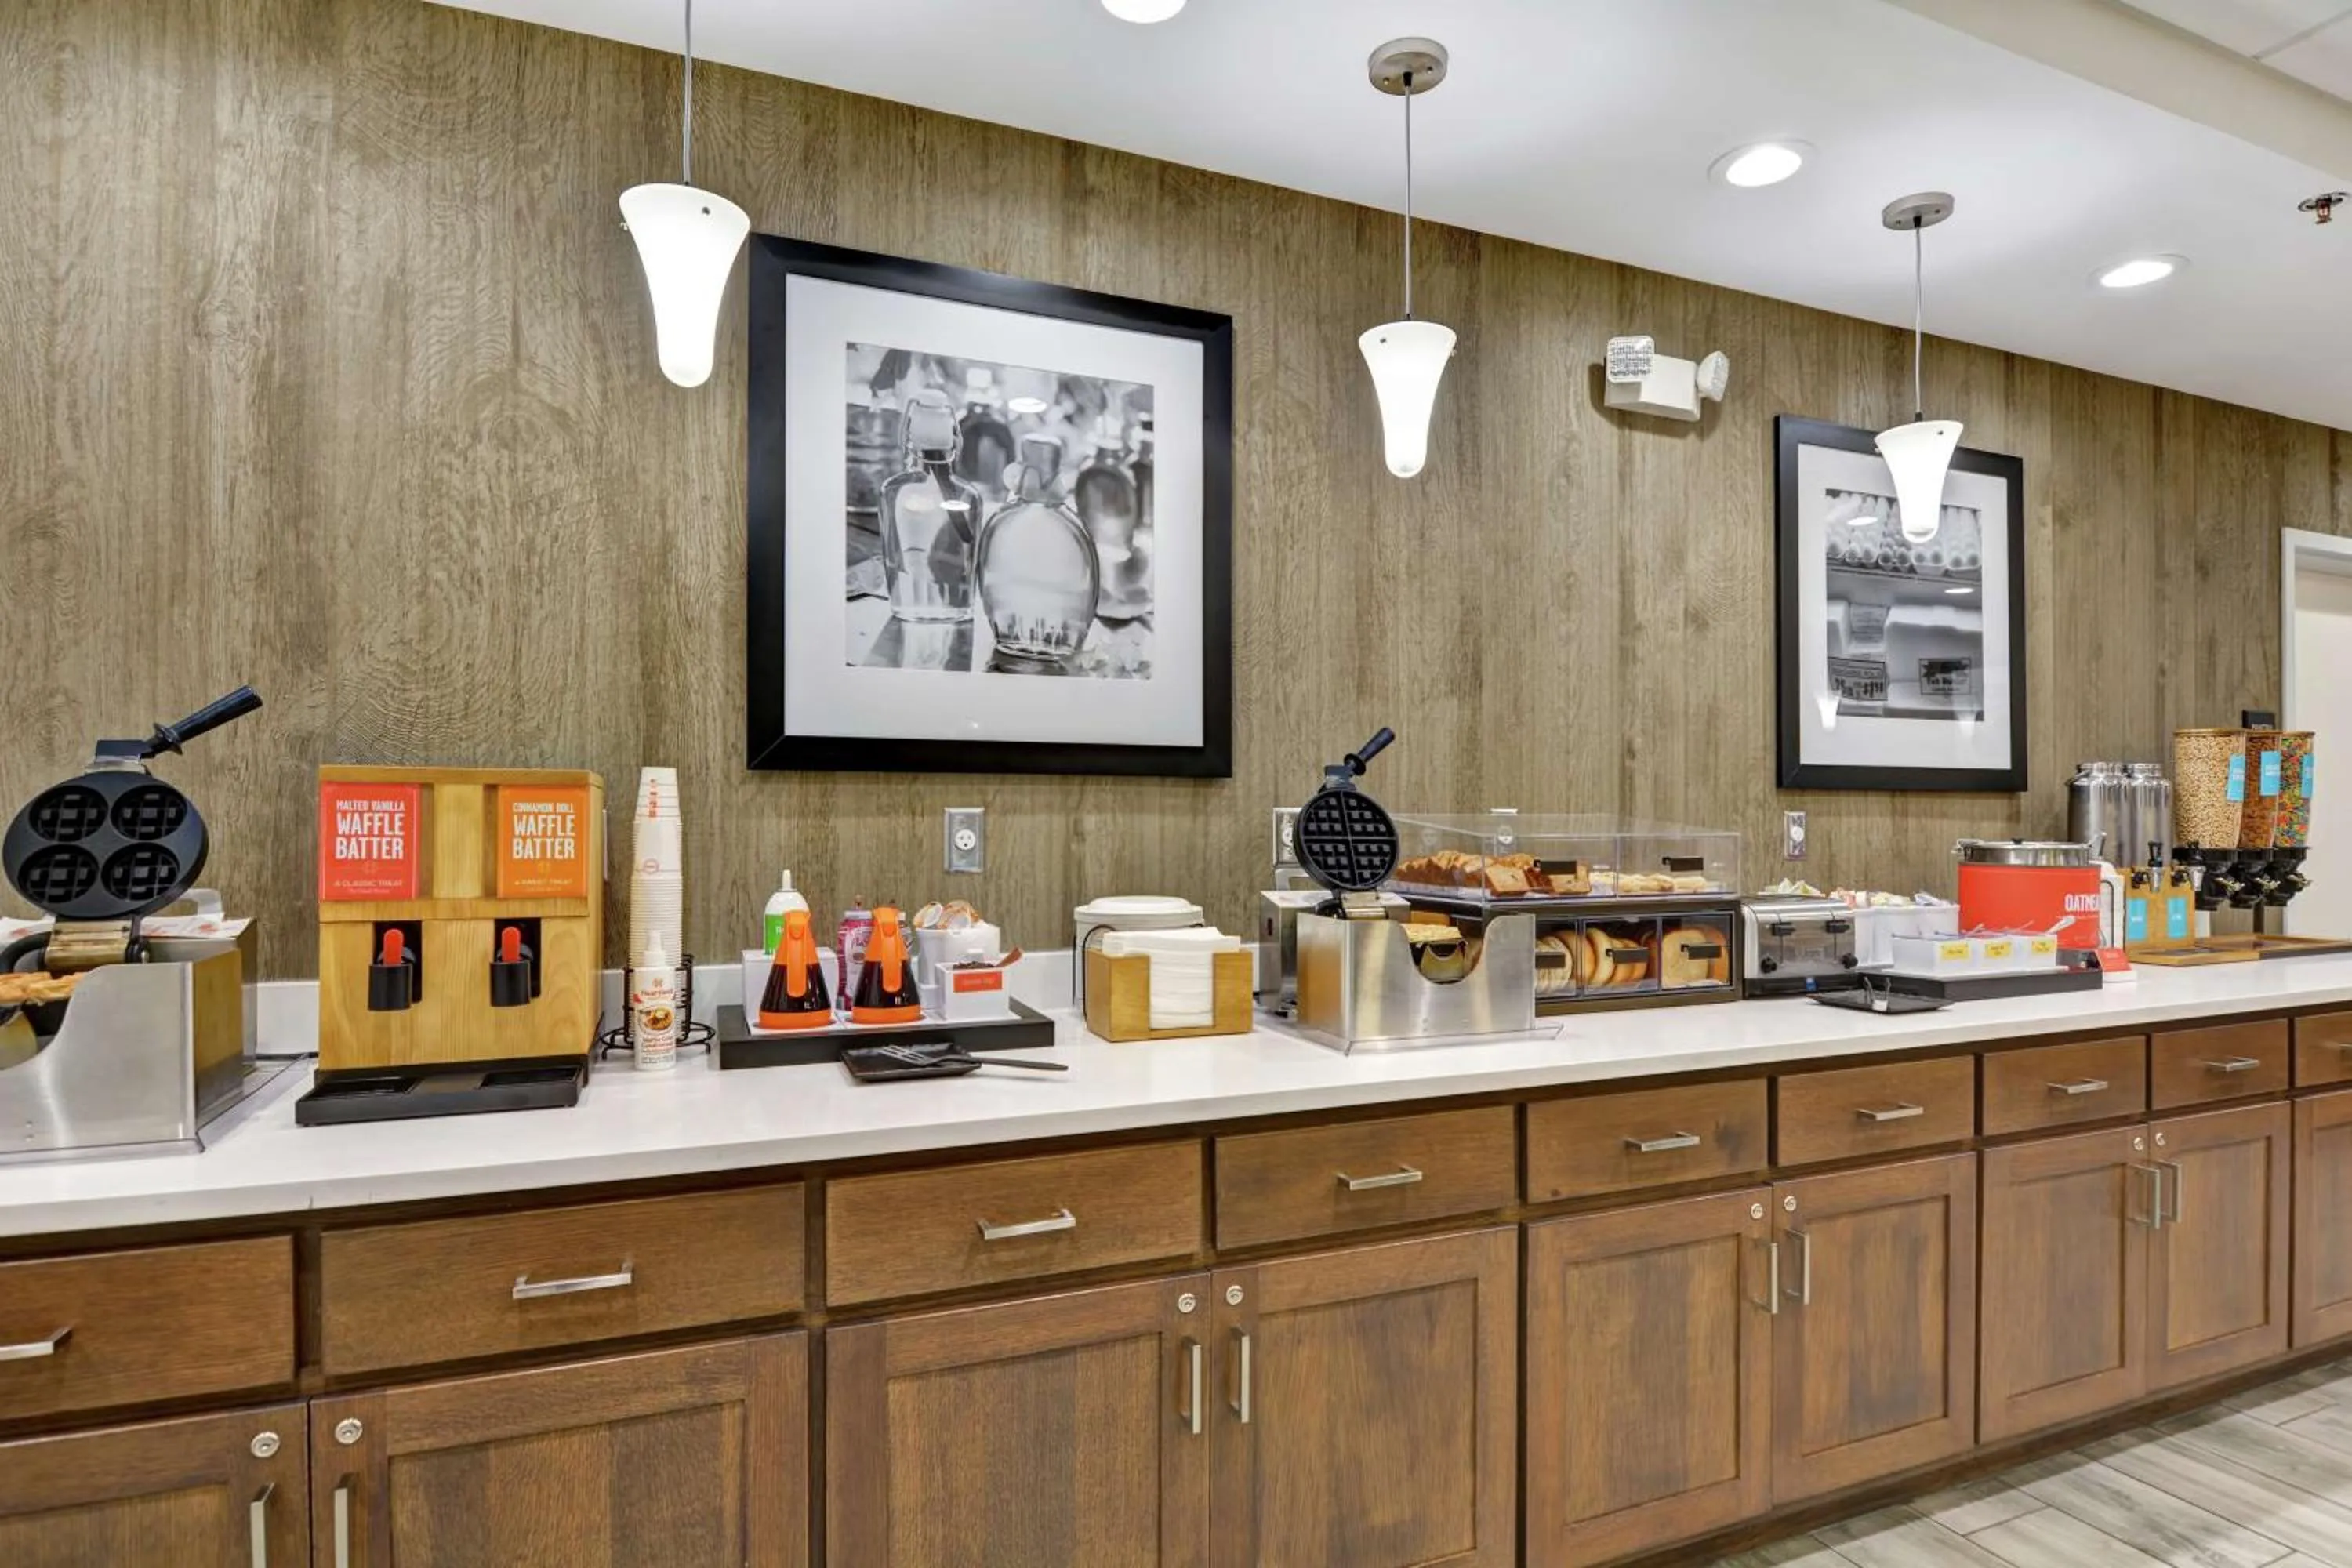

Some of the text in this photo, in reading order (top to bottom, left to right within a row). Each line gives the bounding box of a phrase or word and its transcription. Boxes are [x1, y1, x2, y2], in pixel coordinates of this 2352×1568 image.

[336, 800, 405, 811] MALTED VANILLA
[336, 812, 405, 835] WAFFLE
[514, 815, 575, 837] WAFFLE
[335, 837, 405, 859] BATTER
[513, 838, 575, 859] BATTER
